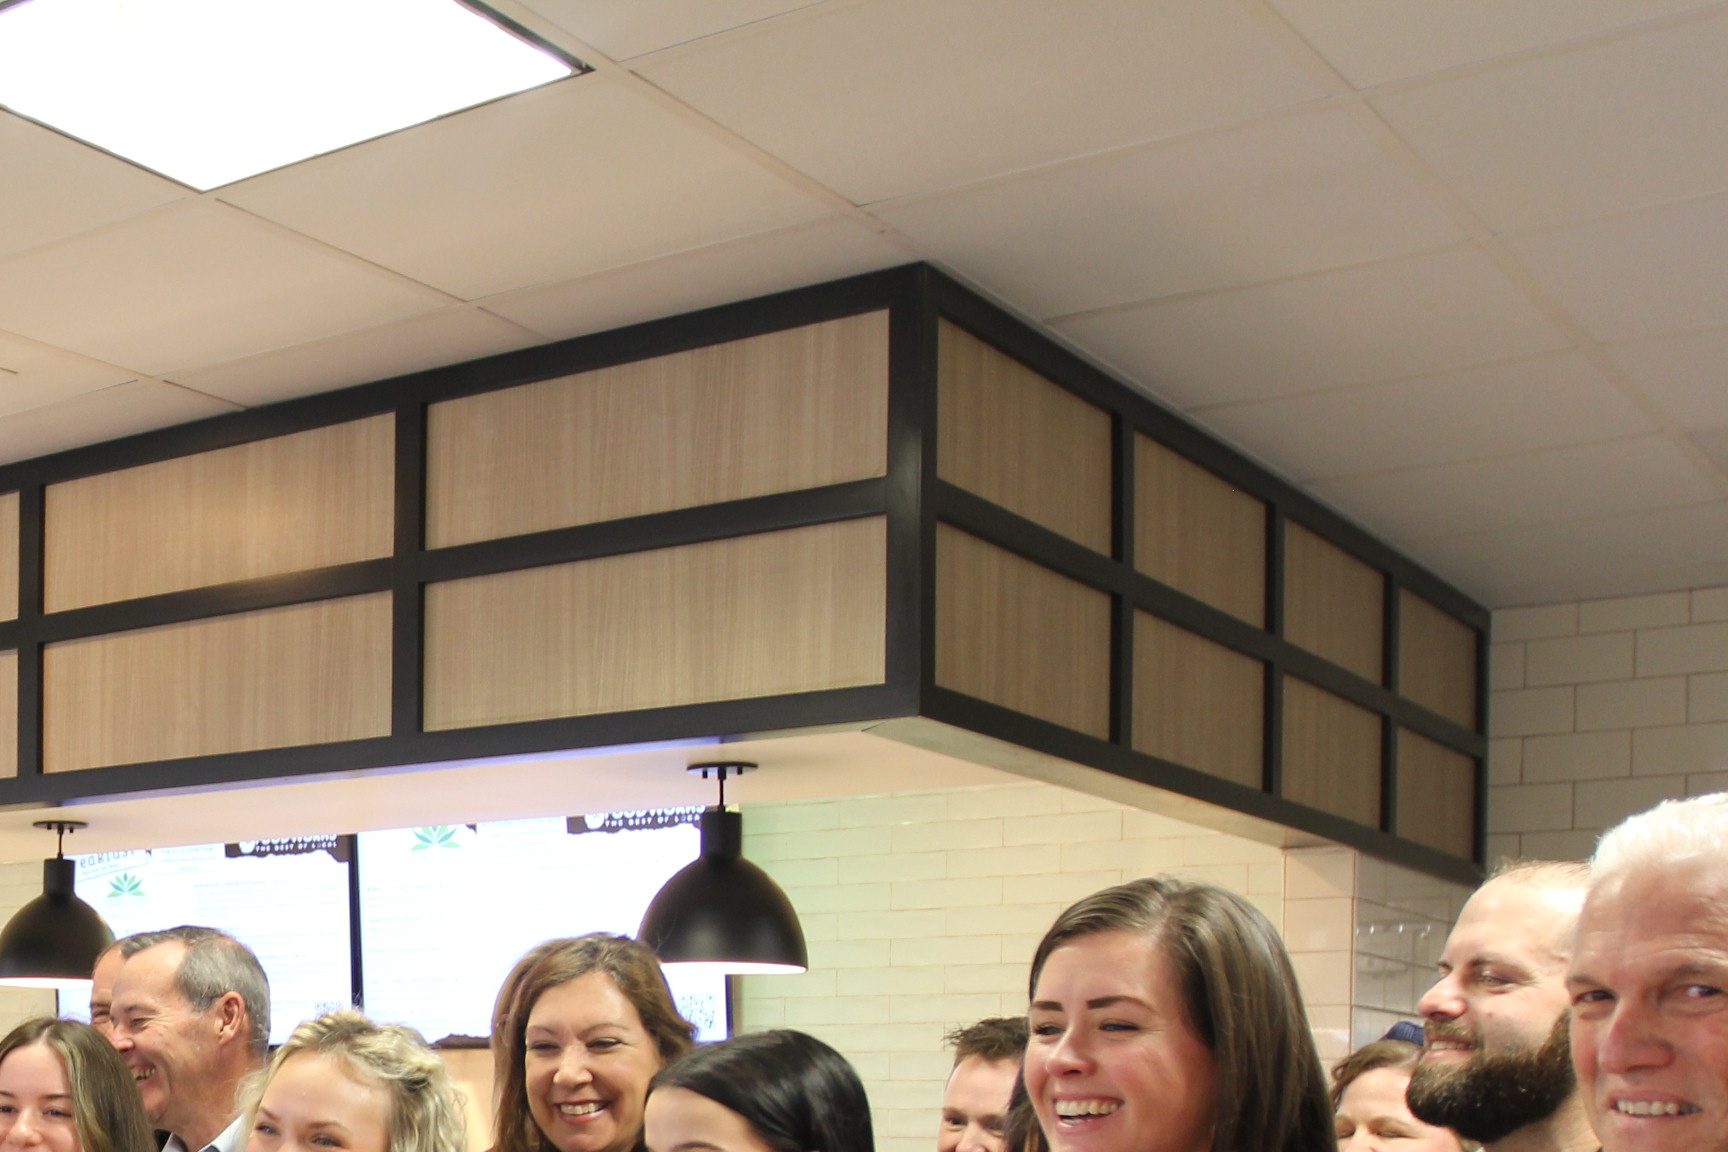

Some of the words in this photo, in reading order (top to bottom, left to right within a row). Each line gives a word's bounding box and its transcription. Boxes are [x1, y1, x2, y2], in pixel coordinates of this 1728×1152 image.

[605, 819, 623, 828] THE
[628, 816, 652, 826] BEST
[657, 815, 669, 824] OF
[298, 842, 308, 850] OF
